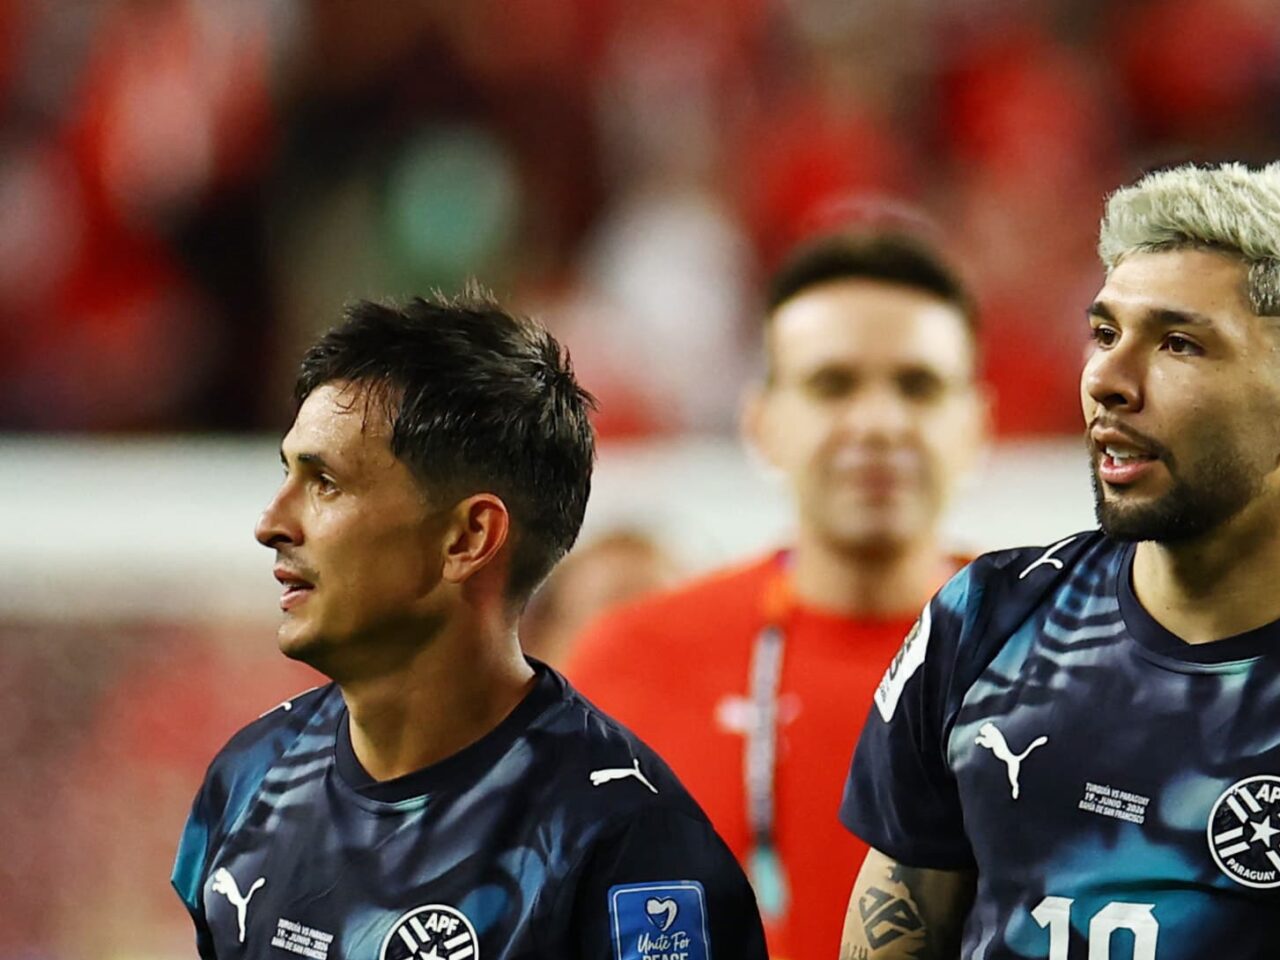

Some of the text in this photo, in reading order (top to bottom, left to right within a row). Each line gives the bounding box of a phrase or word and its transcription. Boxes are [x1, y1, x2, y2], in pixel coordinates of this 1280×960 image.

[1226, 857, 1277, 882] PARAGUAY
[424, 912, 460, 936] APF
[637, 930, 692, 955] Unite For
